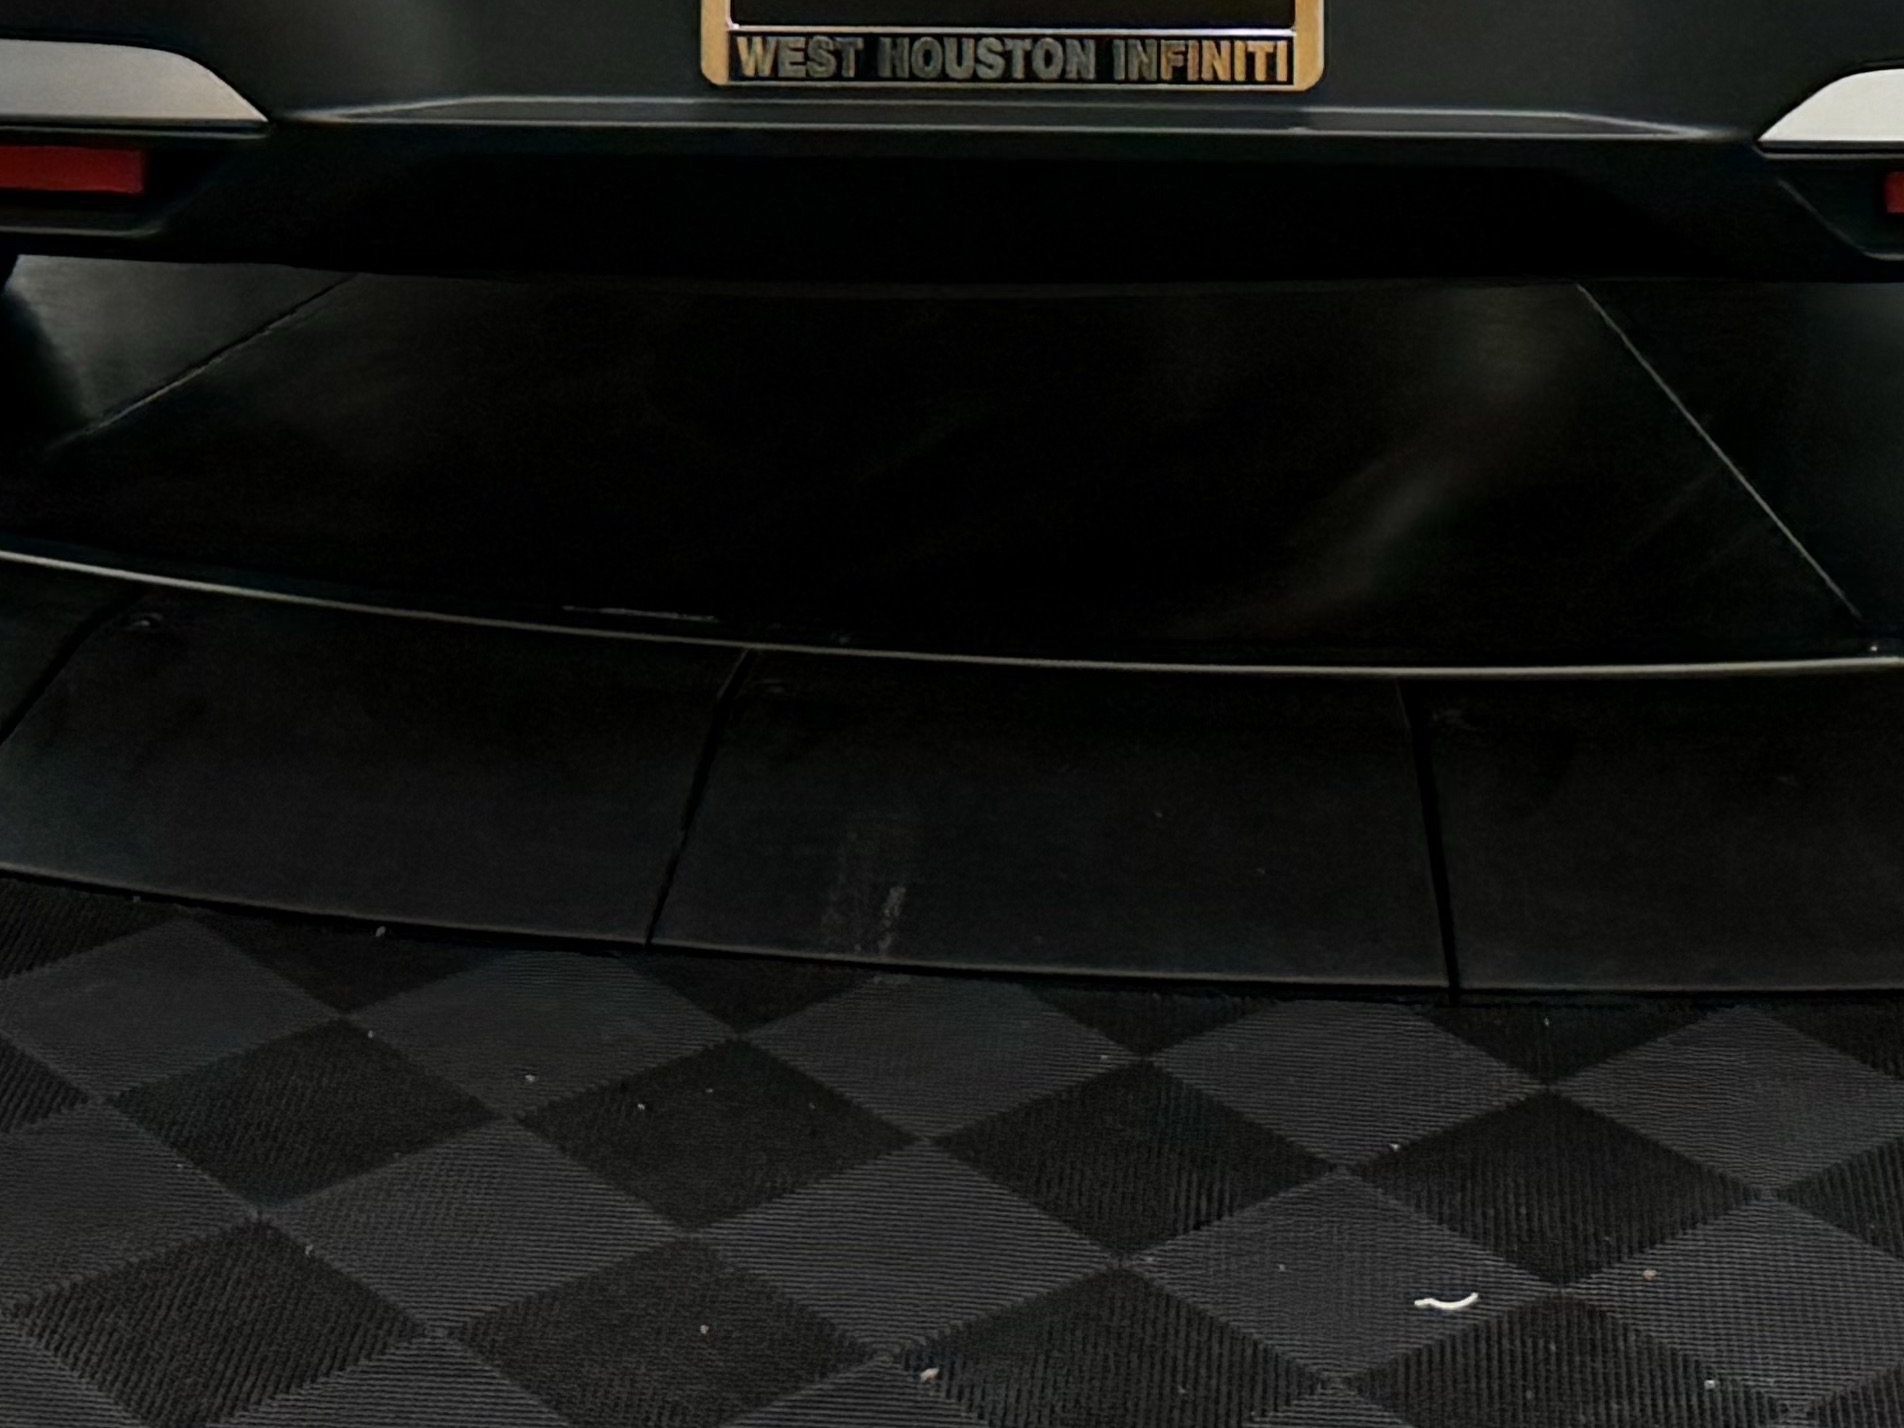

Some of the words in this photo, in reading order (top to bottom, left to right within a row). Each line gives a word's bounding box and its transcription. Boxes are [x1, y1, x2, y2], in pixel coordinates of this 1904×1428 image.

[736, 35, 865, 79] WEST
[877, 35, 1095, 81] HOUSTON
[1111, 38, 1289, 83] INFINITI
